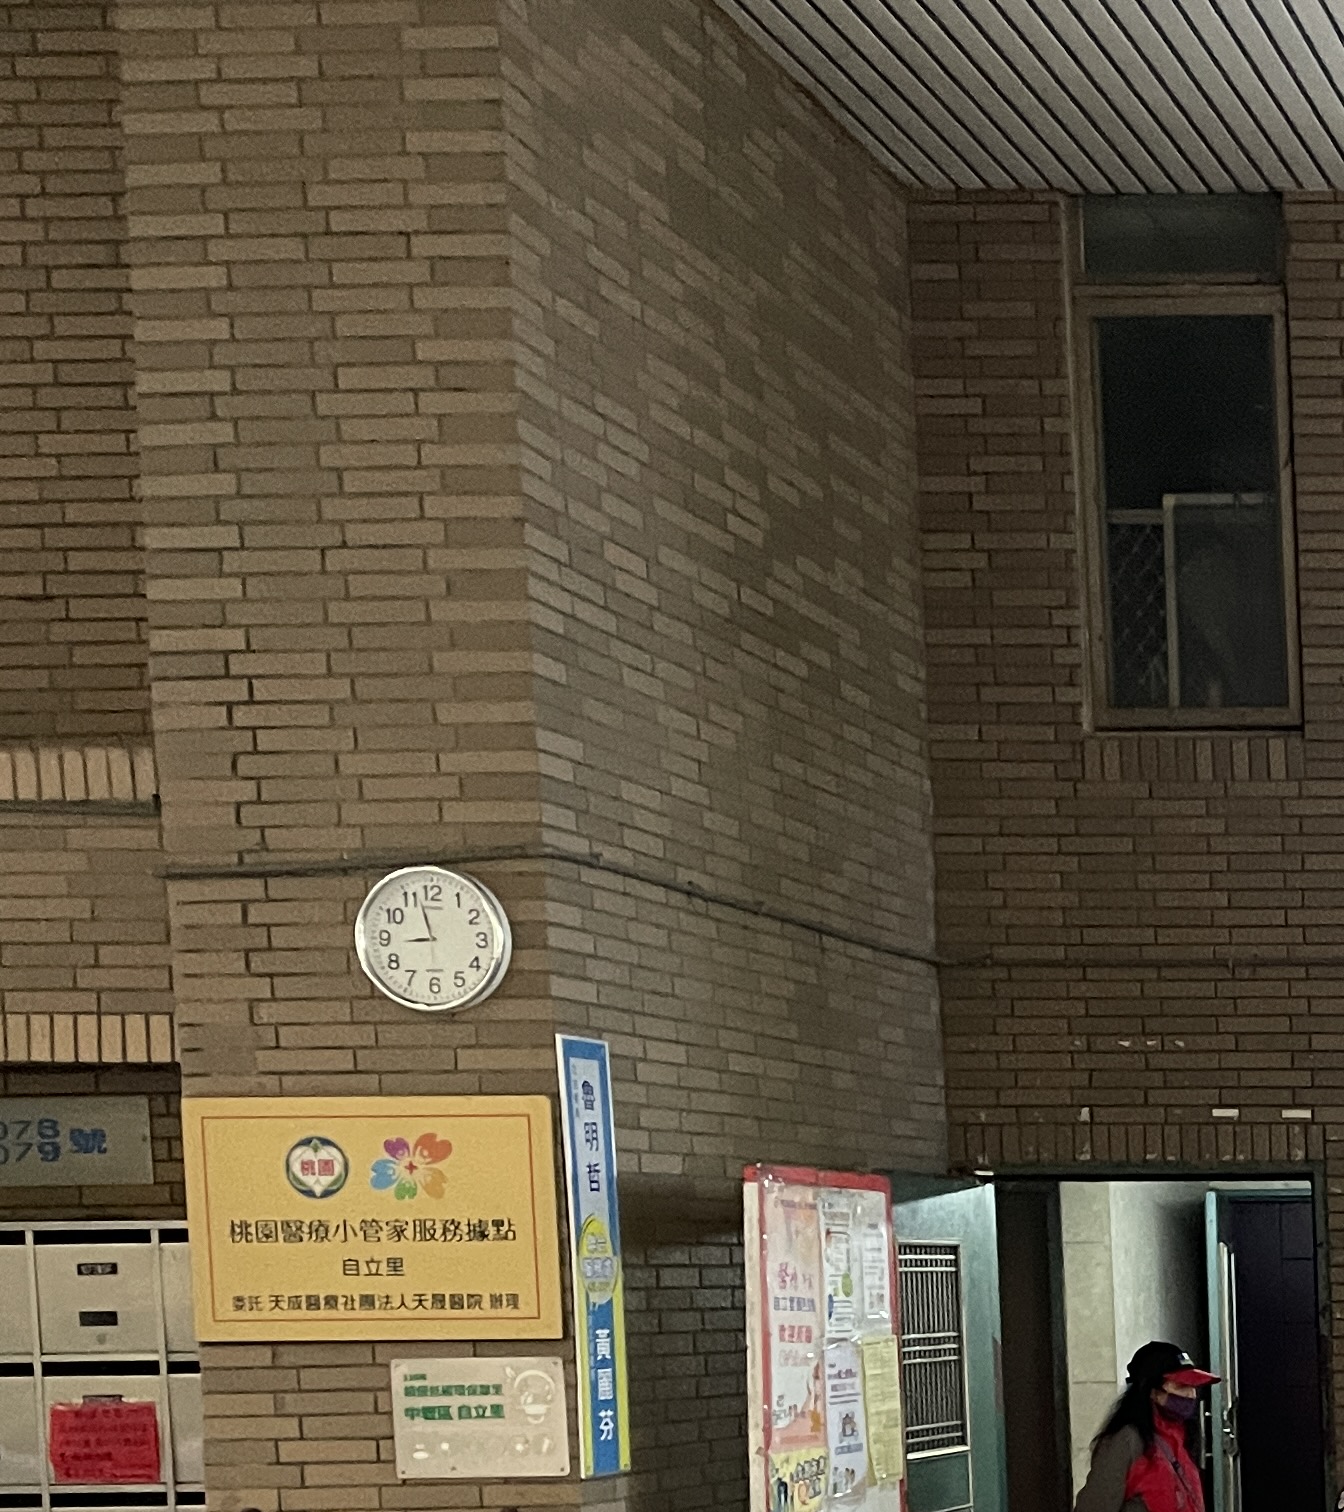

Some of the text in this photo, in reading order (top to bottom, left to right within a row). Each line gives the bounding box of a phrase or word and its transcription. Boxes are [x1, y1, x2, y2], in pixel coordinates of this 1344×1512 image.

[402, 892, 417, 907] 11
[423, 885, 442, 901] 12
[455, 892, 460, 908] 1
[386, 908, 404, 924] 10
[469, 909, 480, 925] 2
[379, 930, 391, 946] 9
[476, 932, 488, 948] 3
[388, 954, 399, 970] 8
[469, 956, 480, 971] 4
[405, 970, 417, 986] 7
[429, 977, 441, 993] 6
[454, 971, 465, 987] 5
[582, 1080, 601, 1192] 魯明哲
[301, 1158, 334, 1177] 桃園
[229, 1218, 517, 1244] 桃園醫療小管家服務據點
[342, 1256, 406, 1278] 自立里
